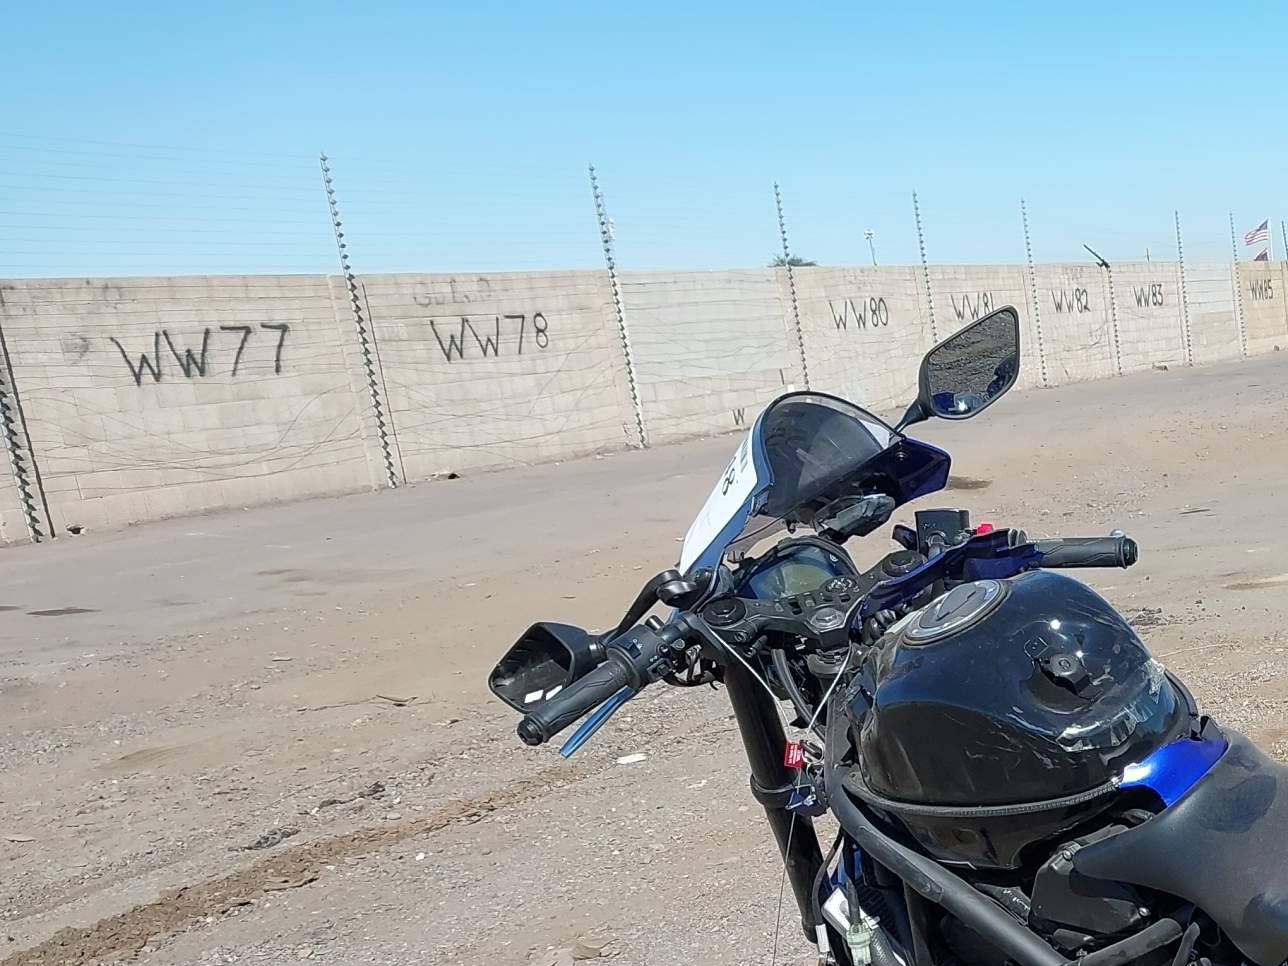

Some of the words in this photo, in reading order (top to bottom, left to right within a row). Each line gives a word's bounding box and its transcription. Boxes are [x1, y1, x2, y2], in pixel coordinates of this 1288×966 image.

[1050, 287, 1091, 314] WW82
[1133, 283, 1164, 308] WW83
[828, 296, 889, 331] WW80
[110, 322, 290, 387] WW77
[430, 312, 549, 362] WW78
